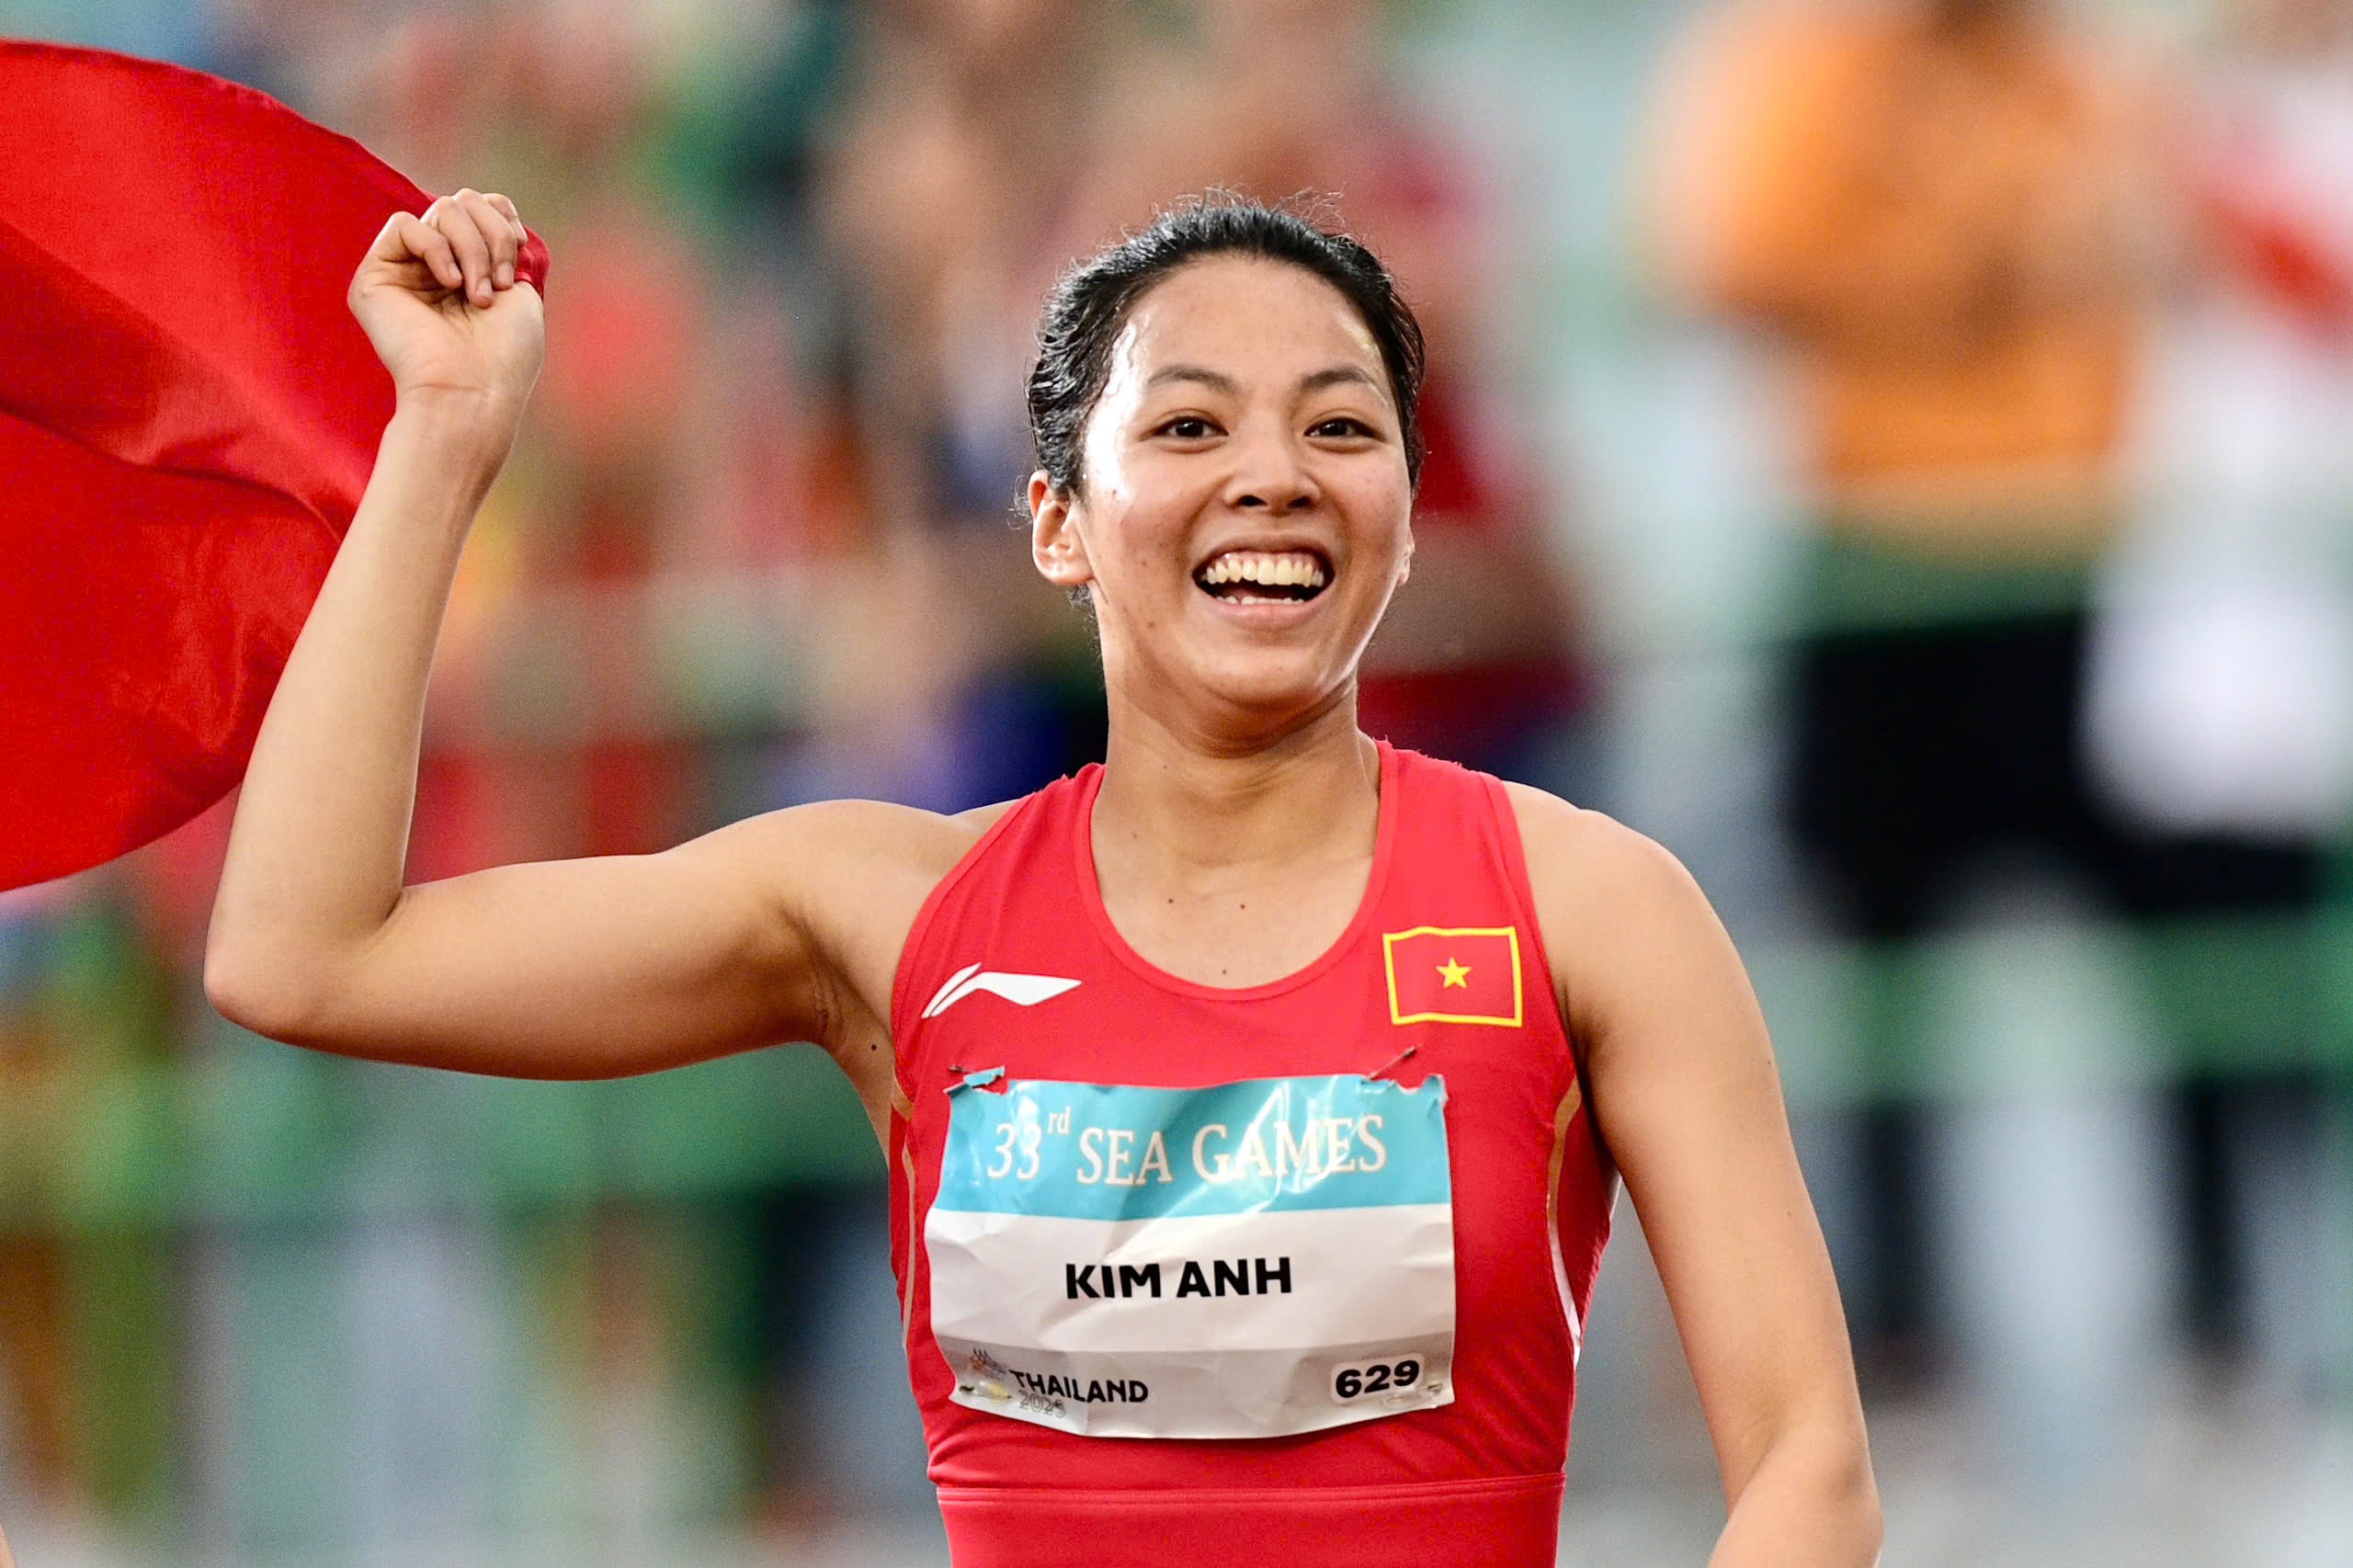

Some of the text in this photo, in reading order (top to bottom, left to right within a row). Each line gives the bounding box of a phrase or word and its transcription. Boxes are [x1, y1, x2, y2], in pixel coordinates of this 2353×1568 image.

[986, 1106, 1388, 1186] 33rd SEA GAMES
[1065, 1256, 1292, 1300] KIM ANH
[1007, 1369, 1149, 1403] THAILAND
[1335, 1359, 1420, 1399] 629
[1017, 1389, 1067, 1418] 2025
